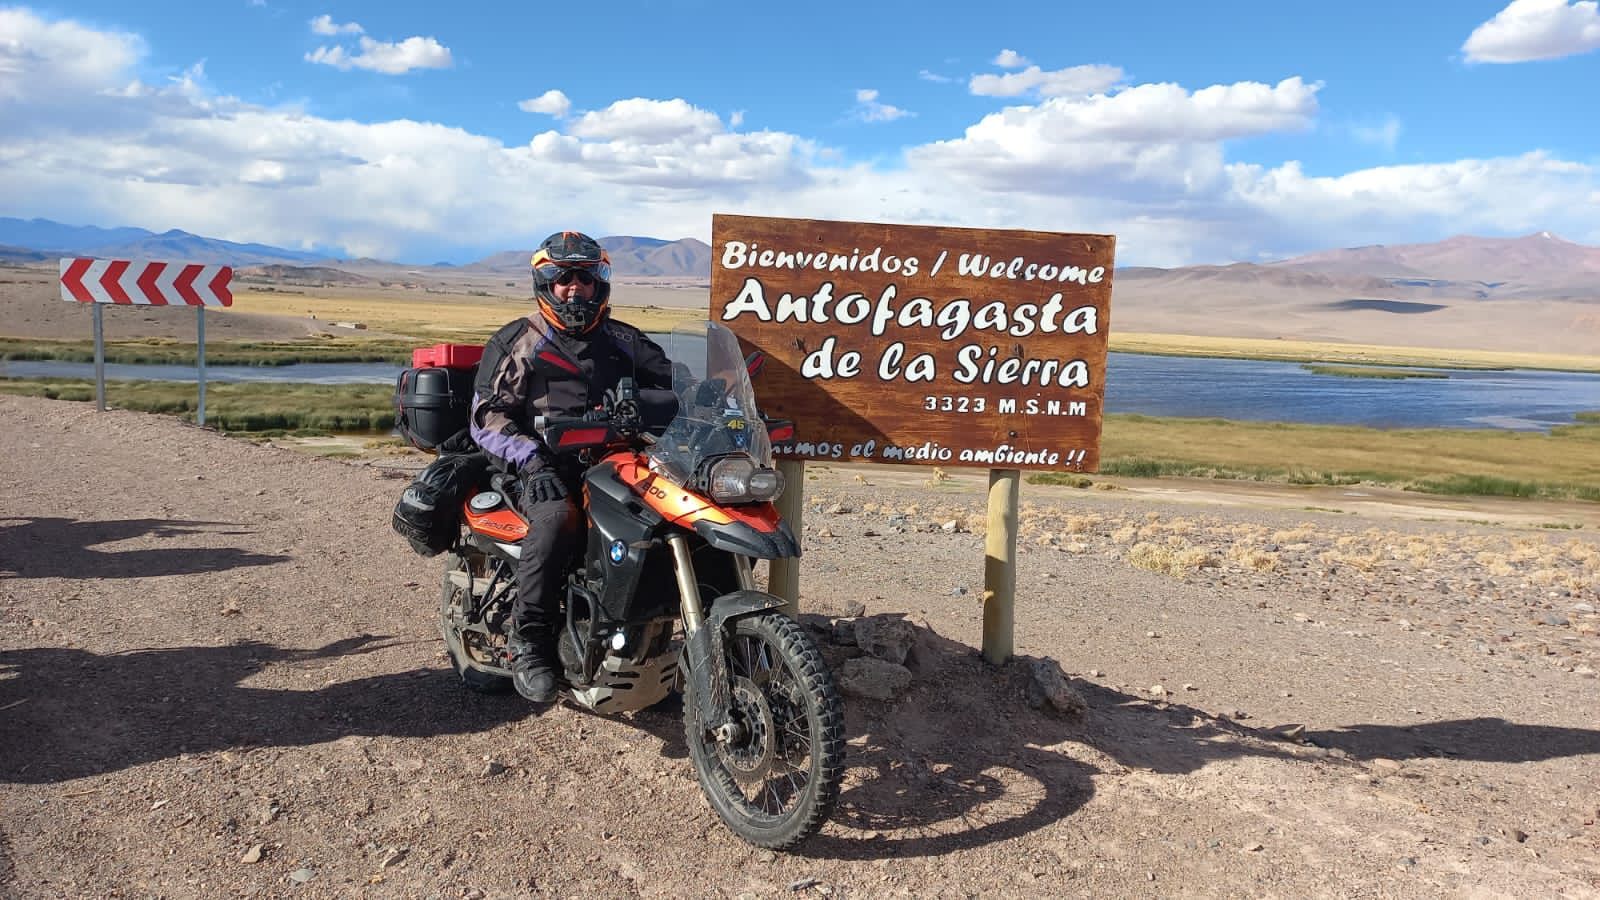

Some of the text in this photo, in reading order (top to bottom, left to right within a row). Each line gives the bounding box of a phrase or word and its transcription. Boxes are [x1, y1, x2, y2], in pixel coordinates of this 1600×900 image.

[721, 241, 1105, 285] Bienvenidos / Welcome
[721, 277, 1098, 341] Antofagasta
[801, 336, 1090, 388] de la Sierra
[925, 396, 985, 413] 3323
[850, 439, 876, 457] el
[883, 442, 953, 460] medio
[959, 444, 1060, 465] ambiente
